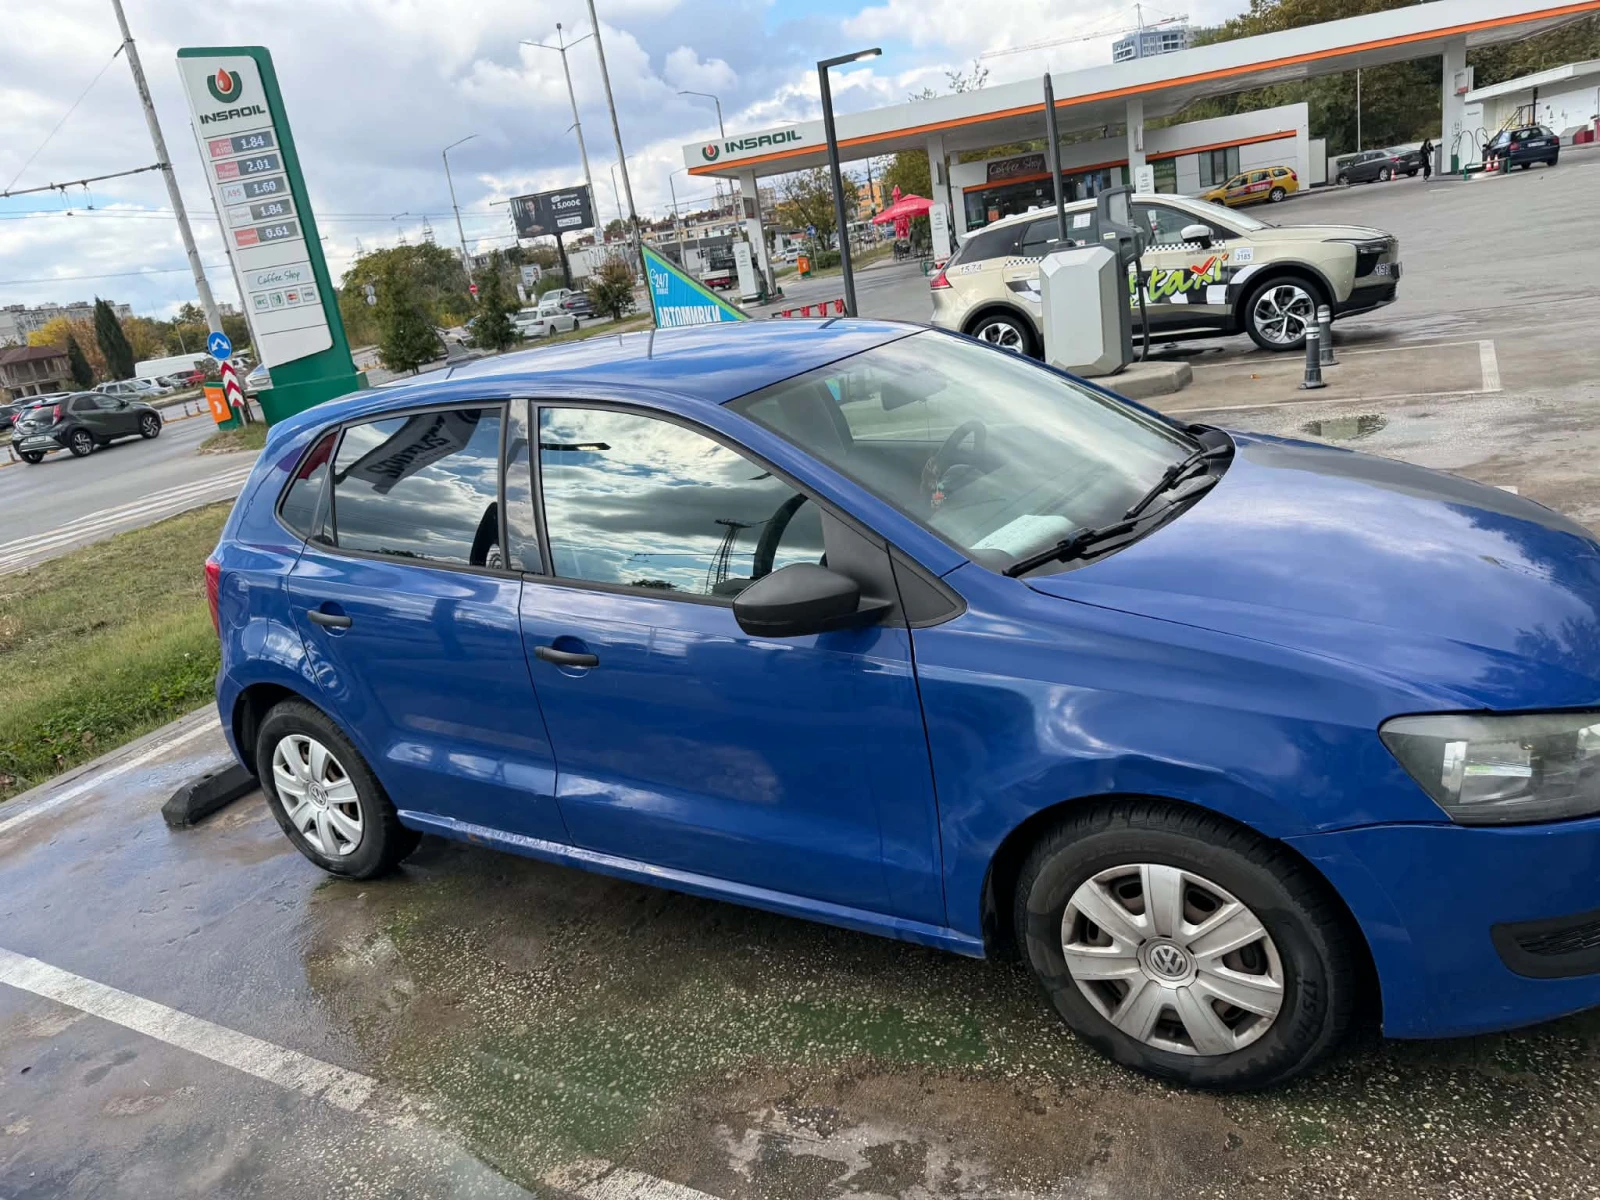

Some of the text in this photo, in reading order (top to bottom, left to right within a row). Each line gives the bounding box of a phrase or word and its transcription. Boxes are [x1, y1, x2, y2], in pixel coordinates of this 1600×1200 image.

[241, 135, 265, 149] 1.84
[246, 158, 271, 172] 2.01
[989, 156, 1042, 175] Coffee Shop
[253, 180, 276, 194] 1.60
[260, 203, 283, 217] 1.84
[557, 198, 582, 209] 5,000€
[265, 225, 290, 238] 0.61
[257, 269, 301, 285] Coffee Shop
[1148, 255, 1223, 301] taxi
